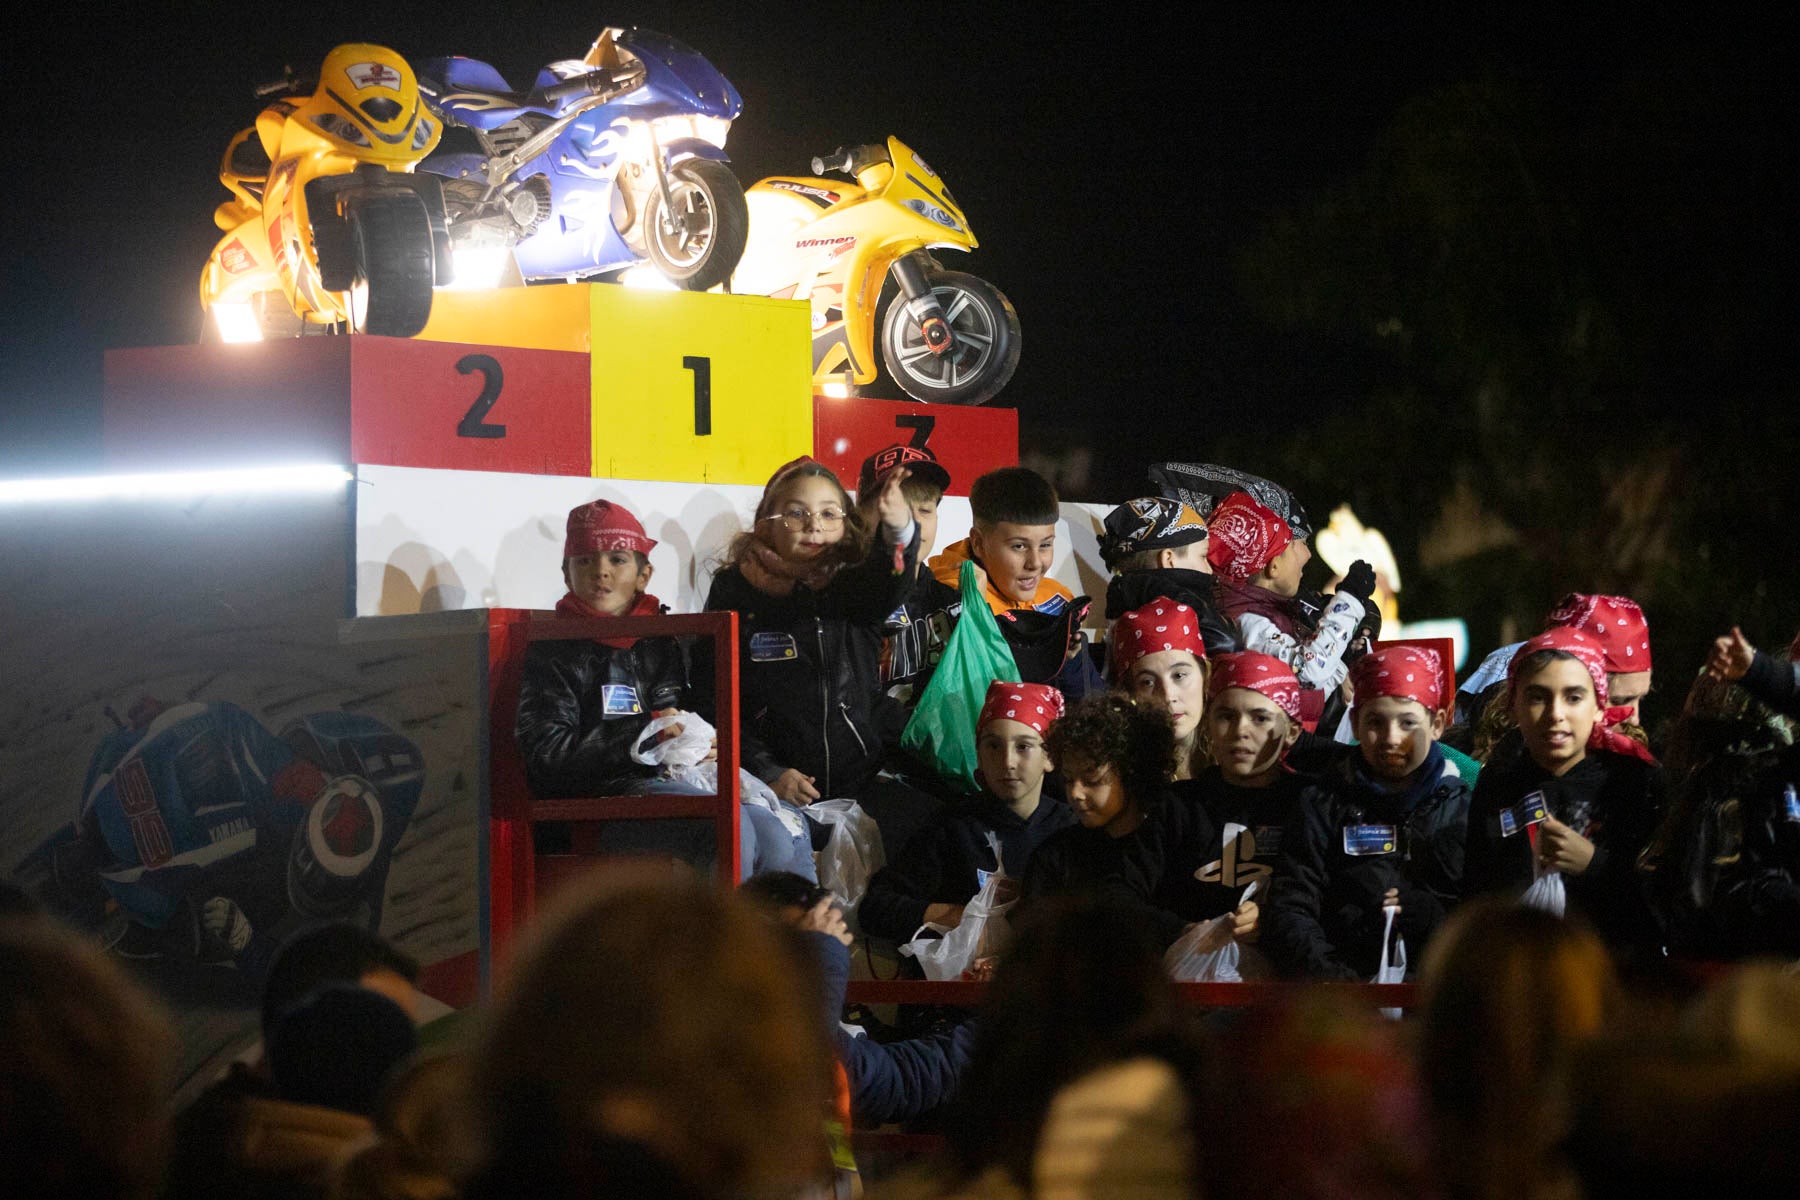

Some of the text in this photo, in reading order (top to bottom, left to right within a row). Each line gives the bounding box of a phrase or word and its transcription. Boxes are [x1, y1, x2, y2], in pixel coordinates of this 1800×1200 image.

[796, 236, 855, 249] Winner
[455, 354, 507, 438] 2
[682, 356, 712, 436] 1
